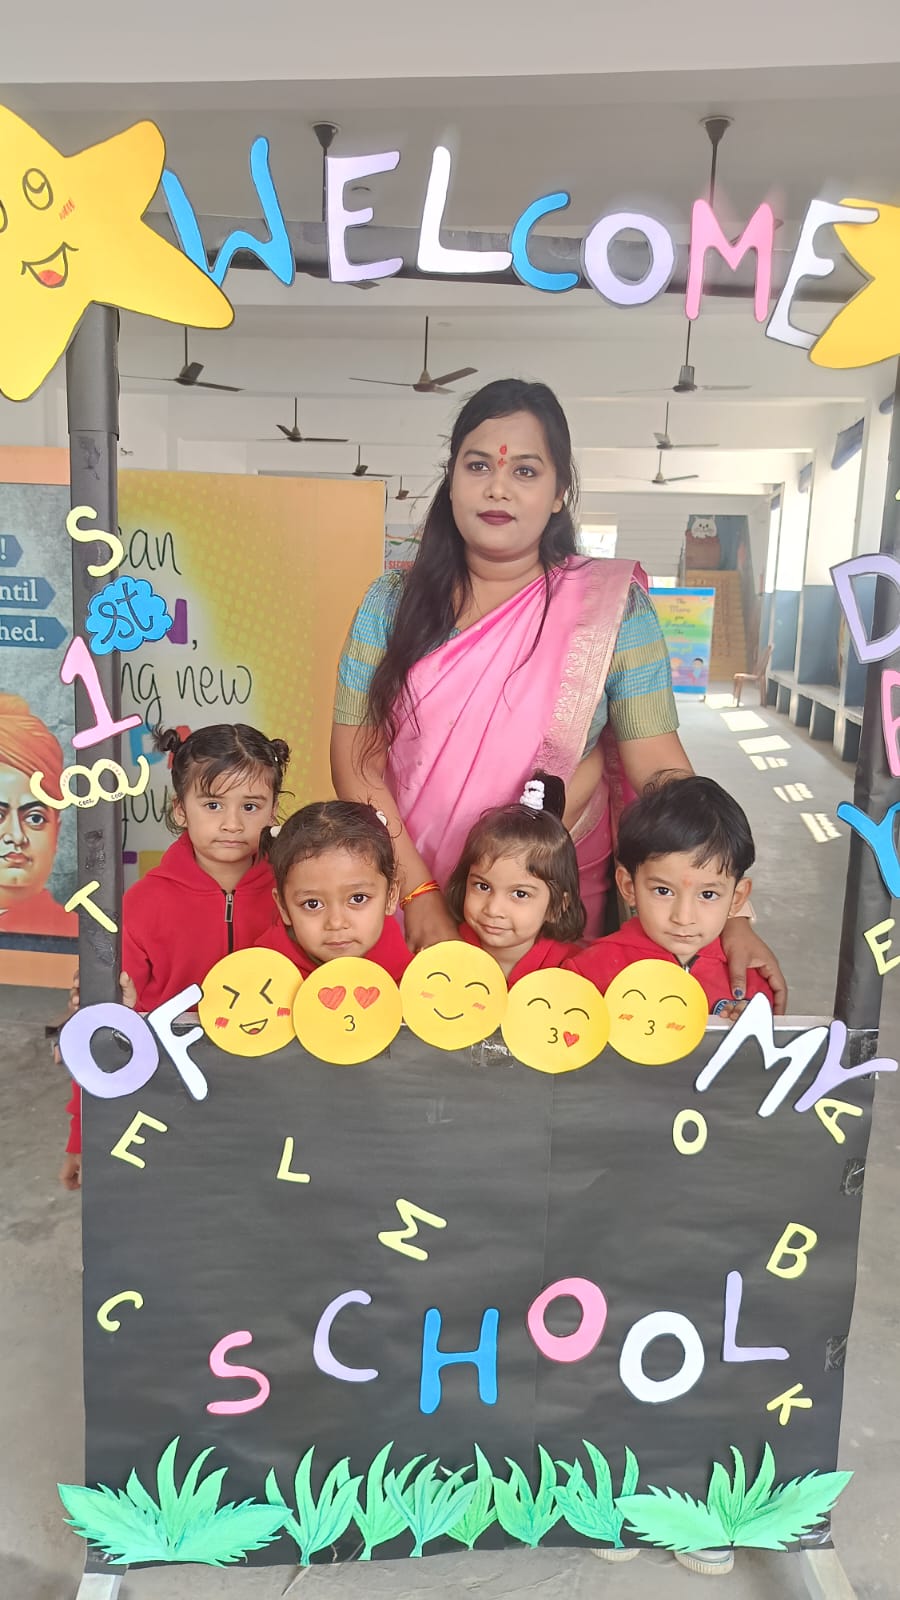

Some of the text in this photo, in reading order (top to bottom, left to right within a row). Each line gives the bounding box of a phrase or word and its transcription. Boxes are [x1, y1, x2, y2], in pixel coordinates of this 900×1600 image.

[163, 136, 879, 350] WELCOME
[0, 579, 38, 602] ntil
[118, 526, 182, 576] an
[176, 665, 252, 707] new
[59, 983, 208, 1101] OF
[694, 993, 899, 1117] MY
[206, 1270, 790, 1415] SCHOOL
